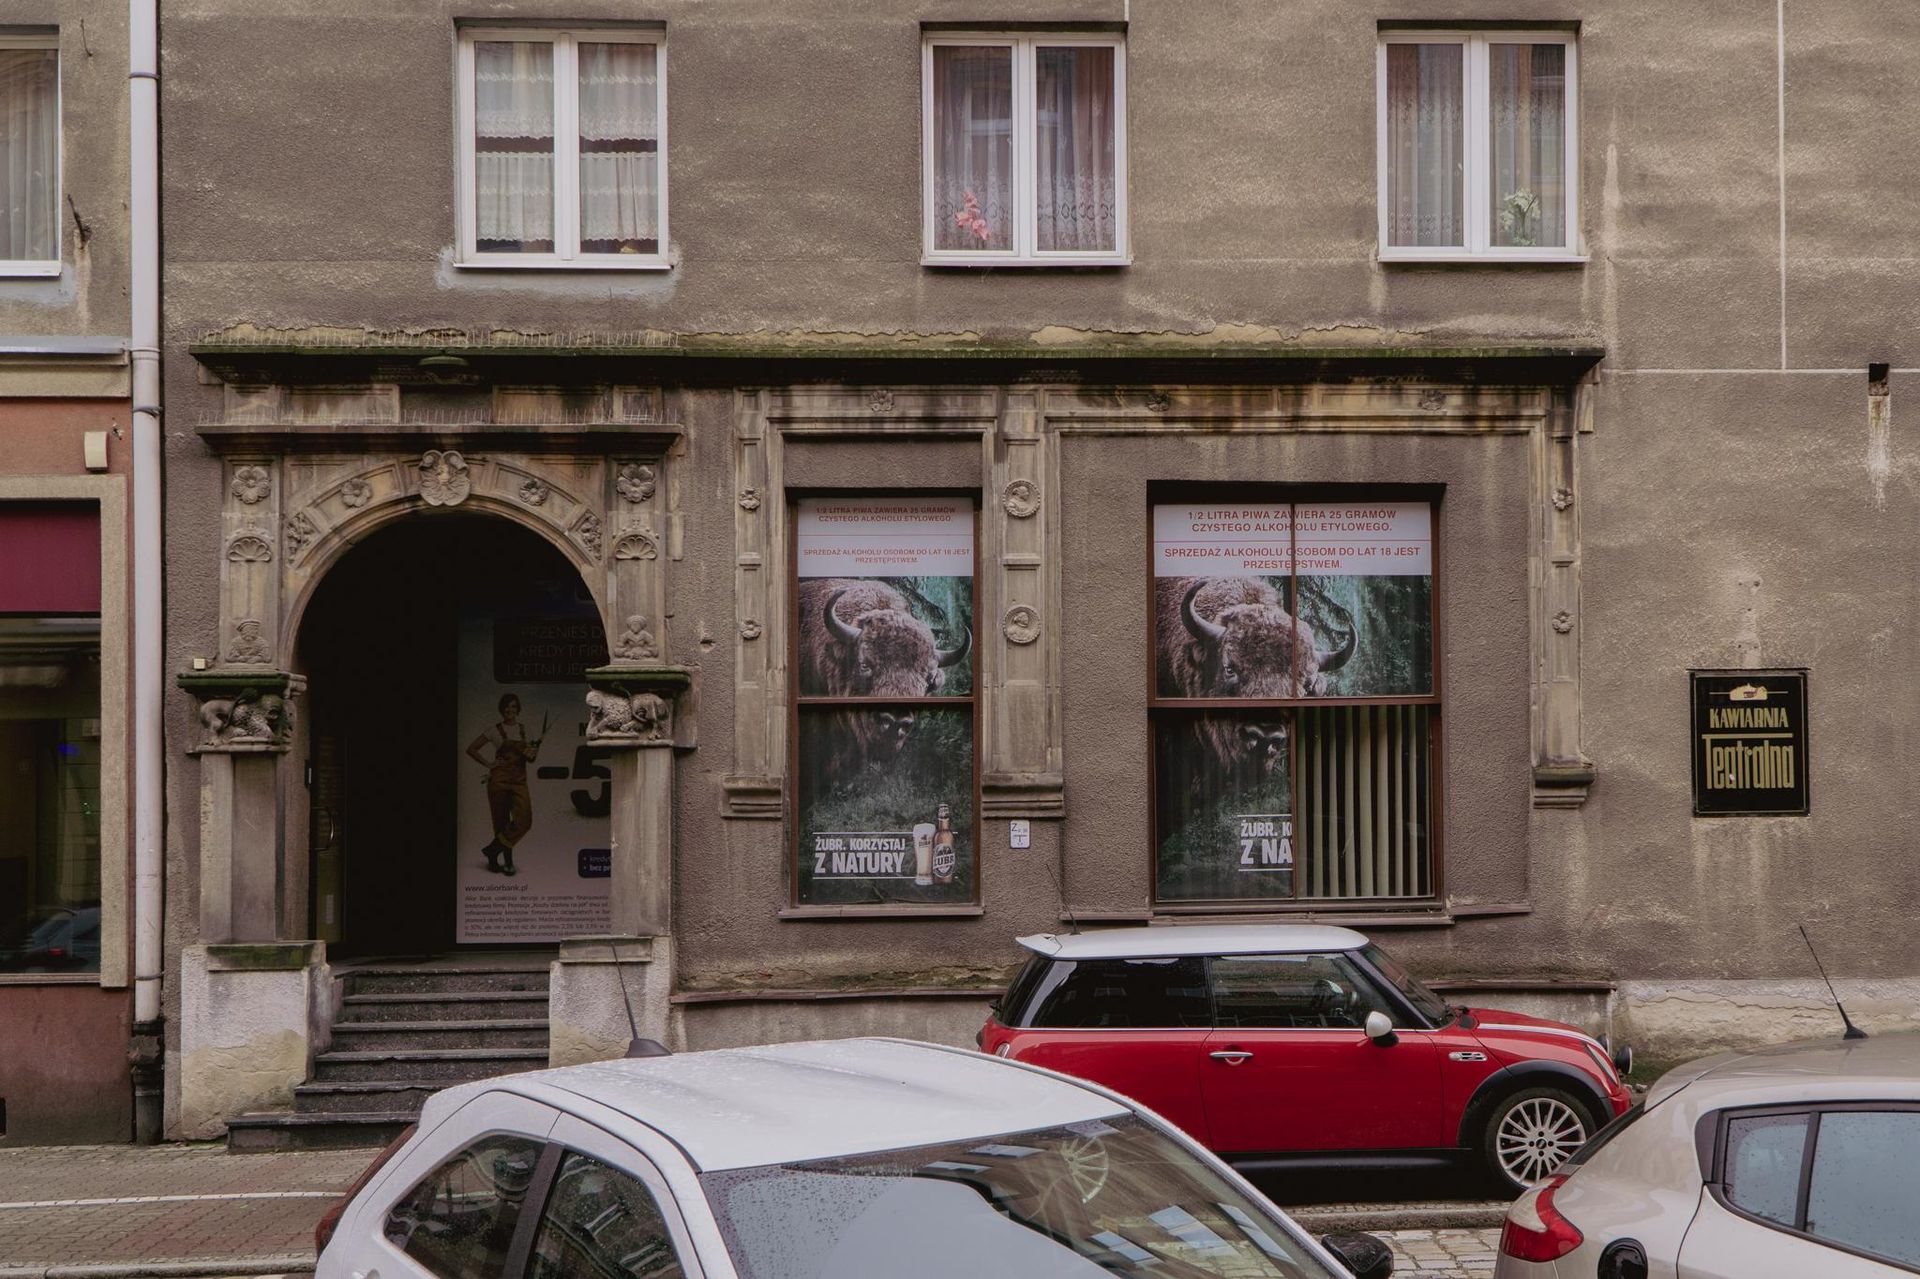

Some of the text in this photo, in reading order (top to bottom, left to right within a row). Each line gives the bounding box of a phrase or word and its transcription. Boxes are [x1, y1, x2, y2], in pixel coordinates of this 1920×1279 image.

[1188, 508, 1397, 521] 1/2 LITRA PIWA ZAWIERA 25 GRAMÓW
[1191, 521, 1393, 533] CZYSTEGO ALKOHOLU ETYLOWEGO.
[916, 548, 928, 556] DO
[929, 548, 943, 556] LAT
[1164, 546, 1421, 558] SPRZEDAŻ ALKOHOLU OSOBOM DO LAT 18 JEST
[1243, 559, 1344, 571] PRZESTĘPSTWEM.
[1709, 707, 1789, 729] KAWIARNIA
[1240, 819, 1278, 837] ŻUBR.
[815, 836, 846, 852] ŻUBR.
[849, 838, 906, 851] KORZYSTAJ
[1240, 838, 1293, 865] Z NA
[814, 851, 905, 874] Z NATURY
